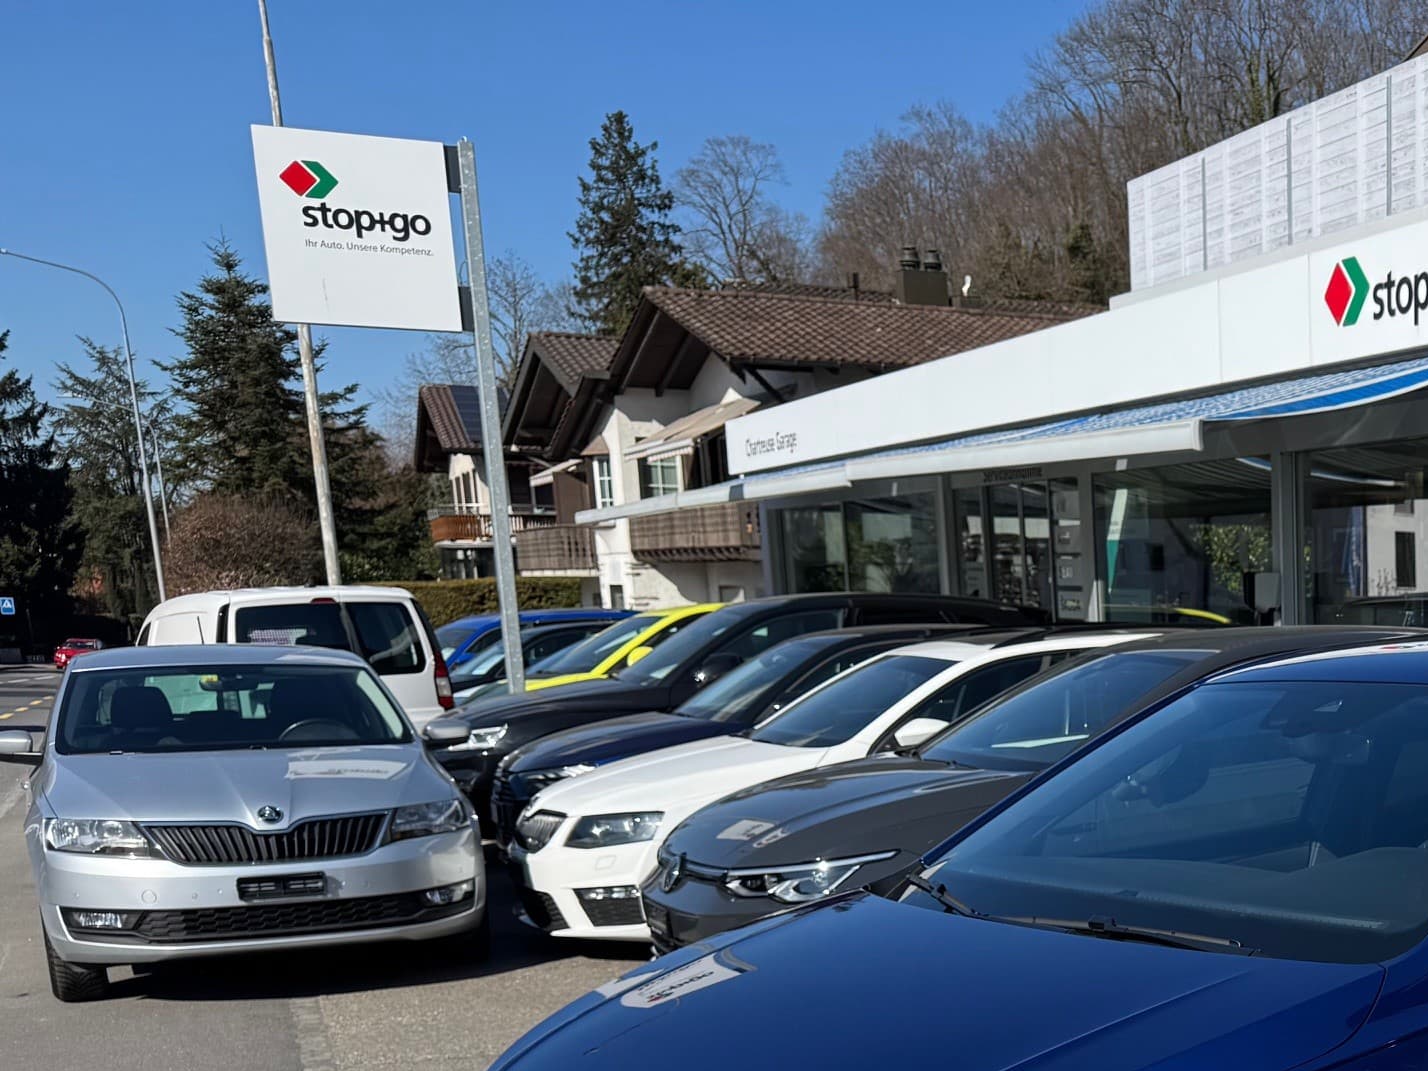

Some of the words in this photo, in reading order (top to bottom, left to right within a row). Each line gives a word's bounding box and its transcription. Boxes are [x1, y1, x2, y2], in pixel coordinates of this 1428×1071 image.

[302, 202, 432, 242] stop+go
[305, 239, 318, 249] Ihr
[320, 240, 345, 250] Auto.
[346, 242, 378, 253] Unsere
[380, 244, 434, 257] Kompetenz.
